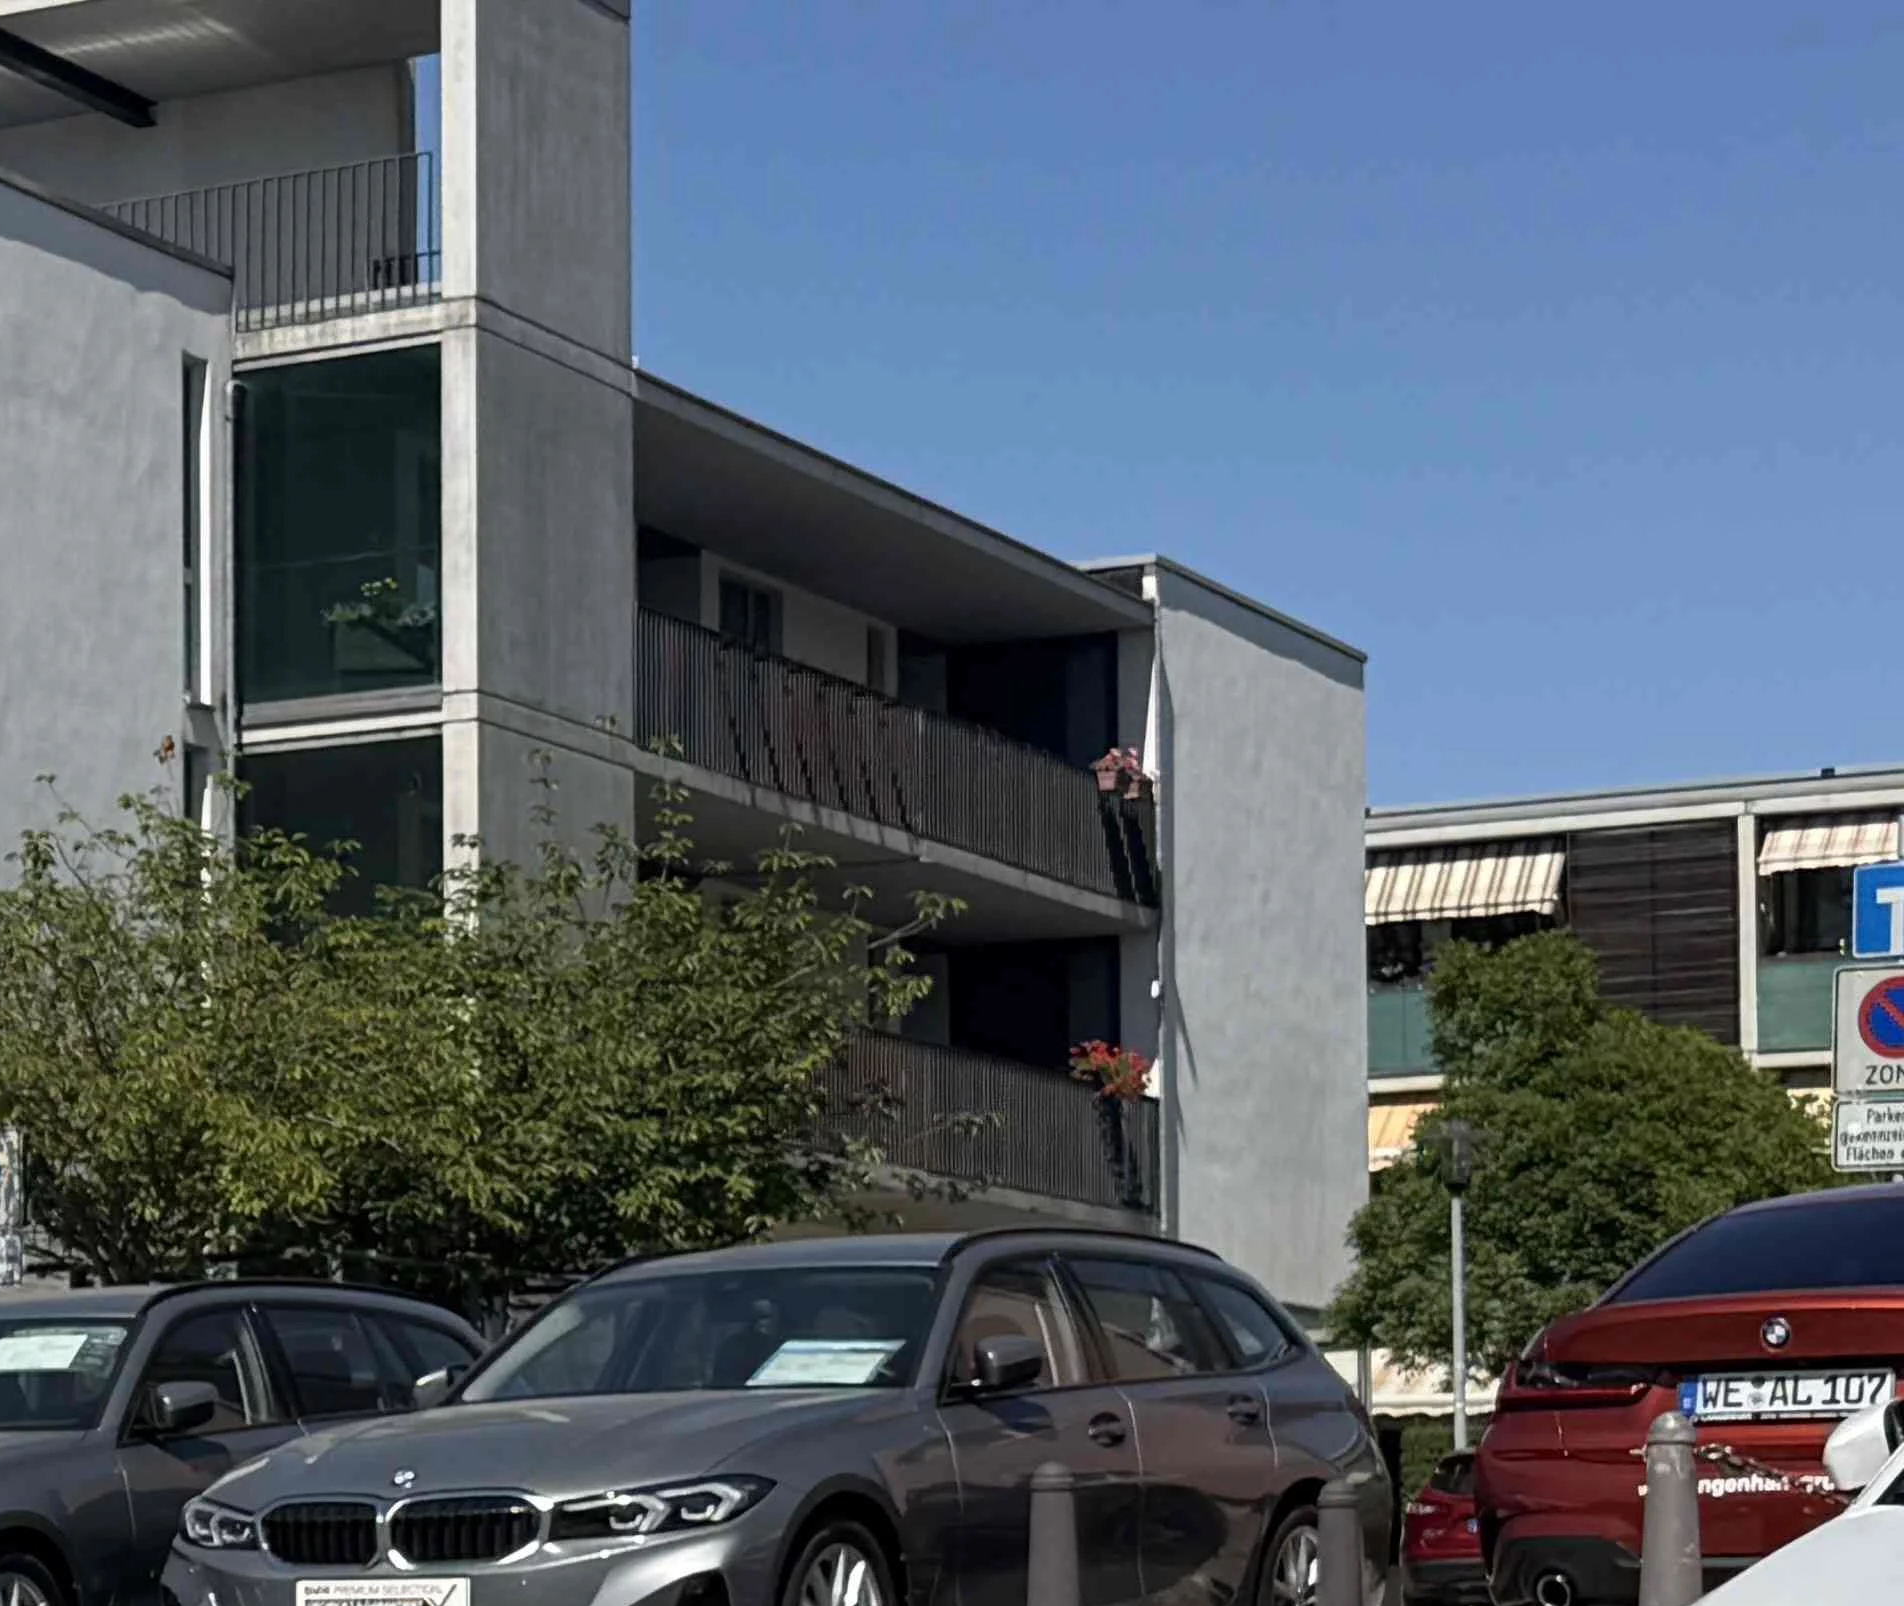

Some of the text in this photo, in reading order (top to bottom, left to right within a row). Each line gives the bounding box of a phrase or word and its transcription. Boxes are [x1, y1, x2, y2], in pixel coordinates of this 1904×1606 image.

[1702, 1378, 1744, 1408] WE
[1769, 1376, 1813, 1406] AL
[1821, 1372, 1889, 1405] 107
